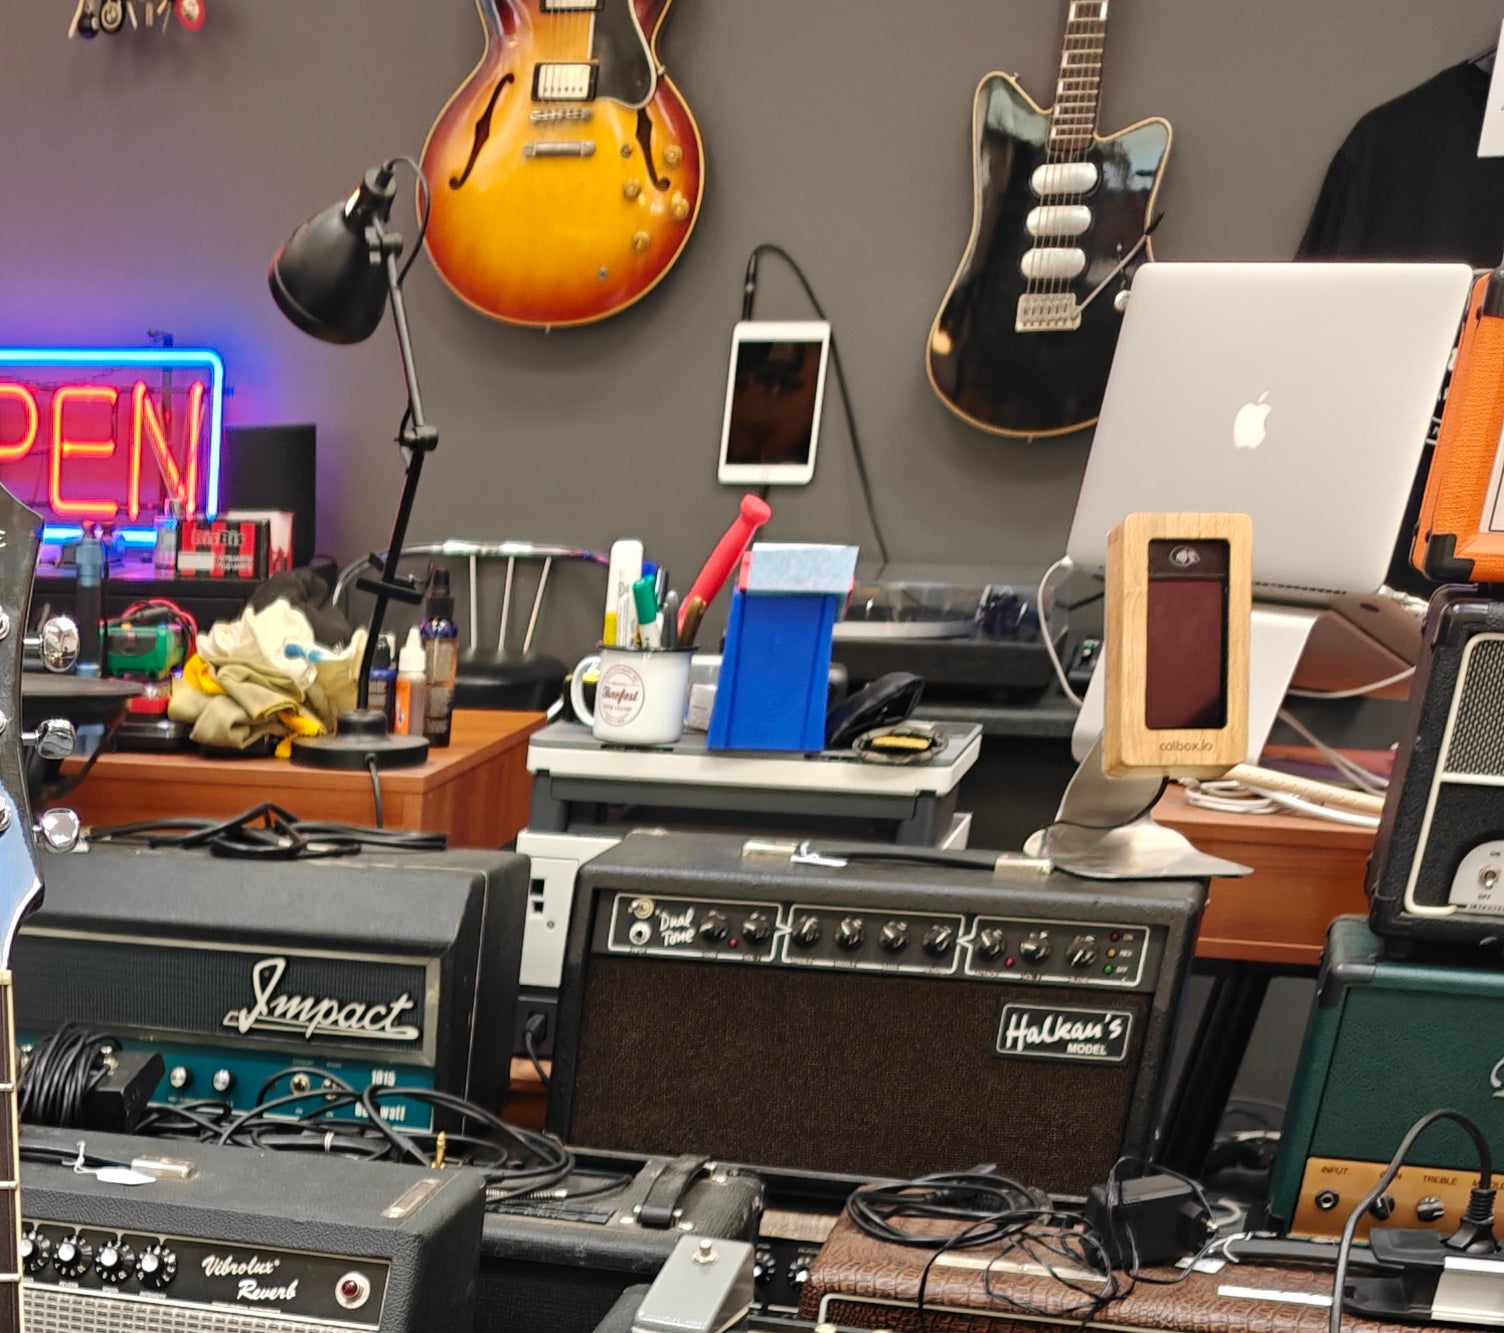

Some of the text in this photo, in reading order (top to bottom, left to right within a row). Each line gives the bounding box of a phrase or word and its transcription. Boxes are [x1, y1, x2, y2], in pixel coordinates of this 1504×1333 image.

[222, 956, 419, 1039] Impact
[1066, 1042, 1108, 1056] MODEL
[380, 1105, 406, 1121] watt
[1320, 1166, 1349, 1175] INPUT
[1423, 1175, 1458, 1185] TREBLE
[201, 1254, 274, 1277] Vibrolux
[236, 1278, 299, 1301] Reverb
